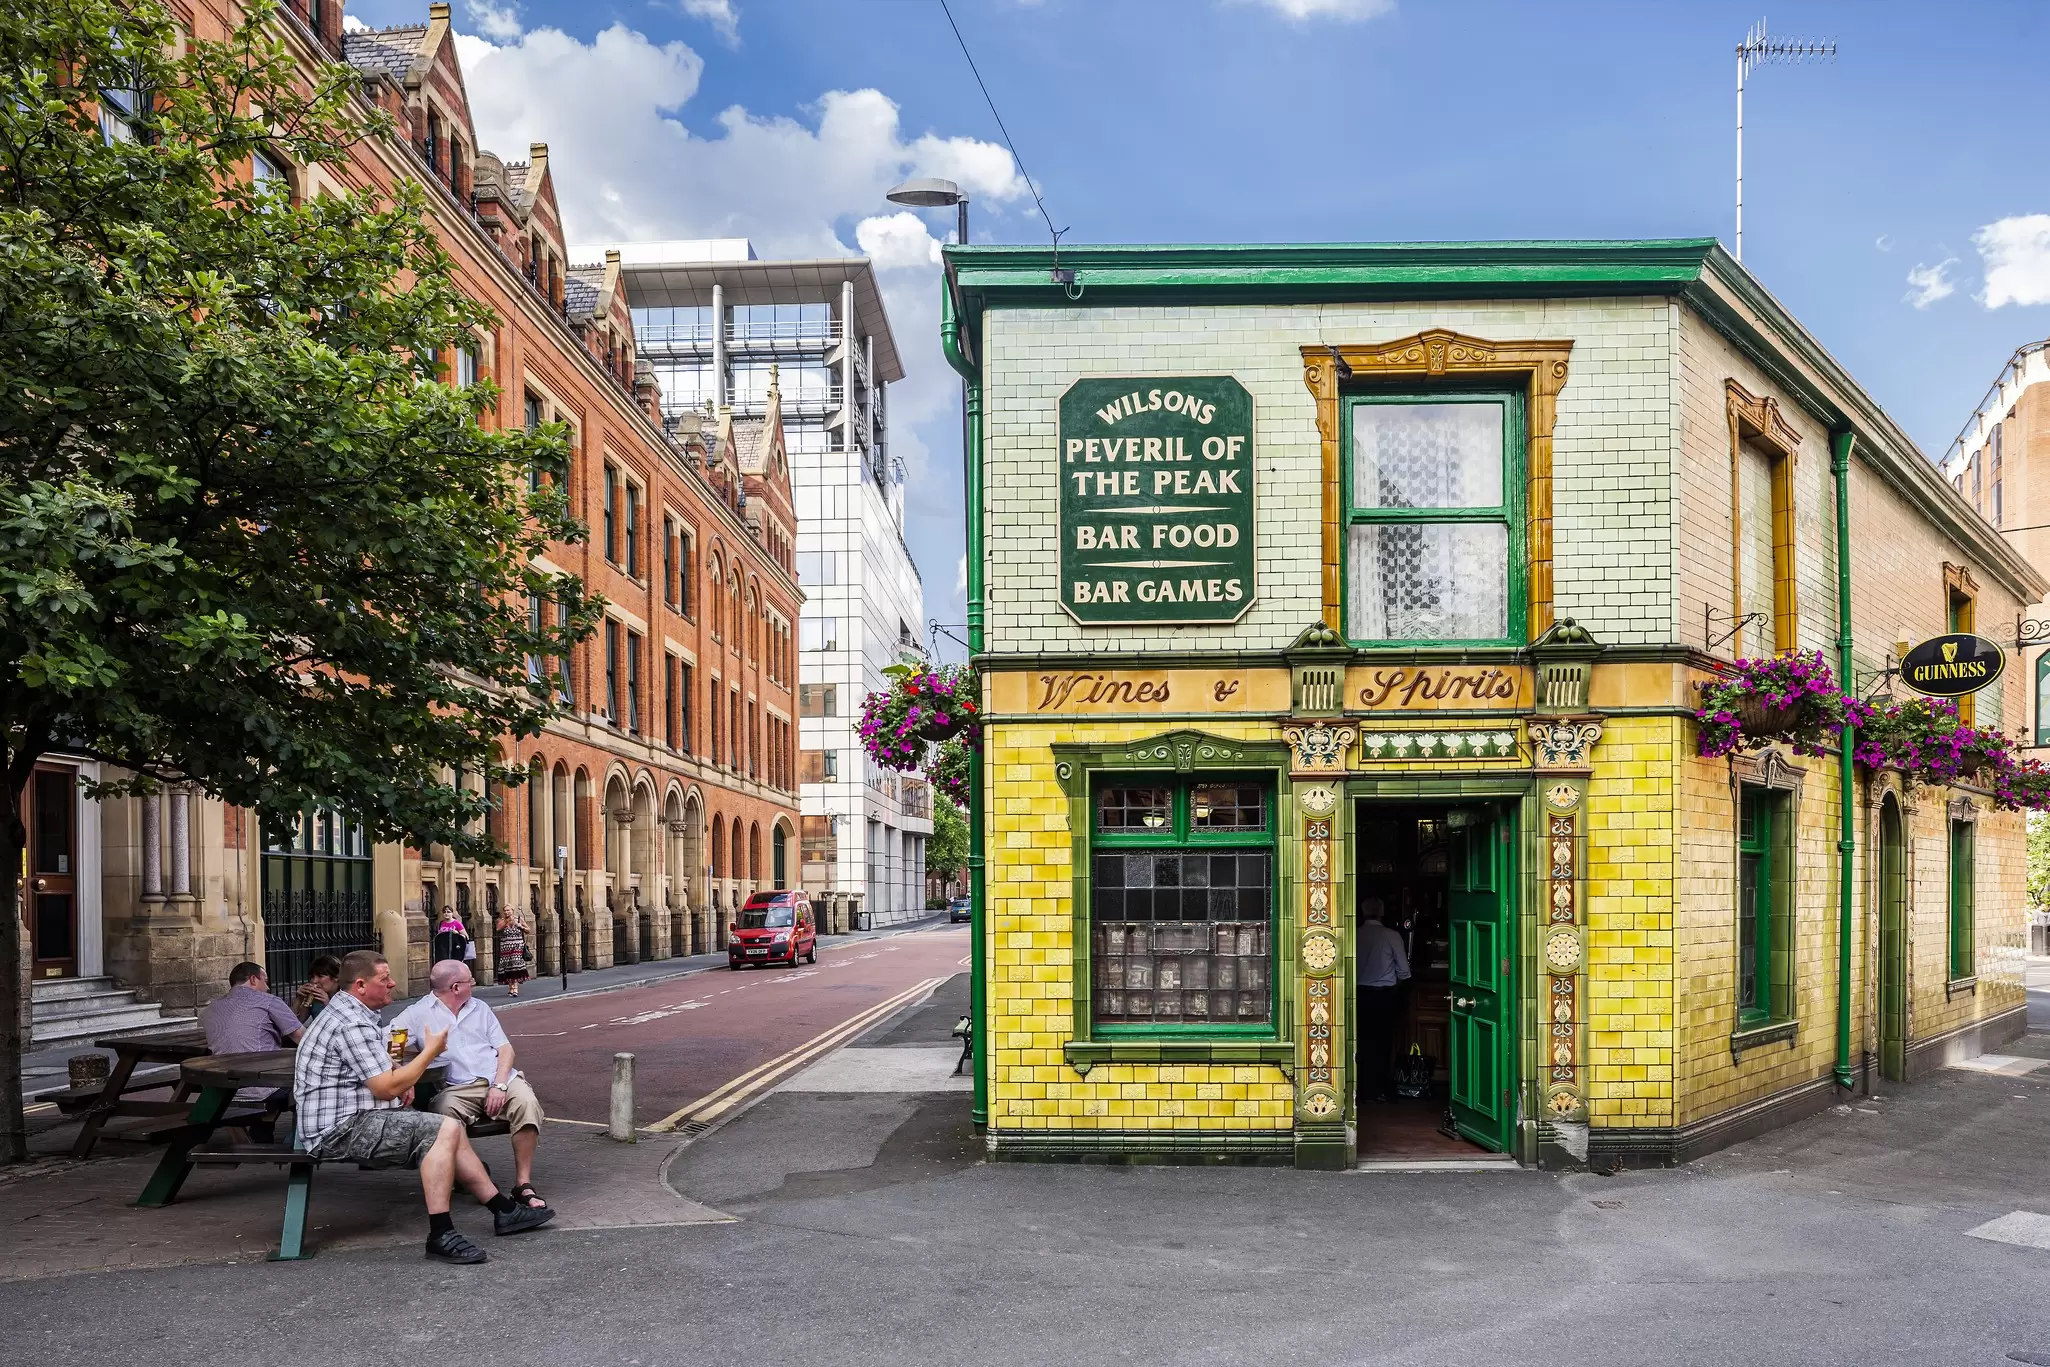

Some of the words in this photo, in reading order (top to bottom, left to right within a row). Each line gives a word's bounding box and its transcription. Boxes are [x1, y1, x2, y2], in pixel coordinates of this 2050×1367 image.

[1096, 389, 1216, 425] WILSONS
[1066, 437, 1191, 462] PEVERIL
[1201, 435, 1244, 460] OF
[1071, 471, 1139, 495] THE
[1153, 469, 1241, 494] PEAK
[1076, 525, 1140, 549] BAR
[1152, 523, 1238, 548] FOOD
[1073, 581, 1130, 603] BAR
[1136, 578, 1242, 602] GAMES
[1913, 660, 1986, 681] GUINNESS
[1038, 674, 1170, 709] Wines
[1213, 679, 1239, 701] &
[1359, 669, 1513, 706] Spirits
